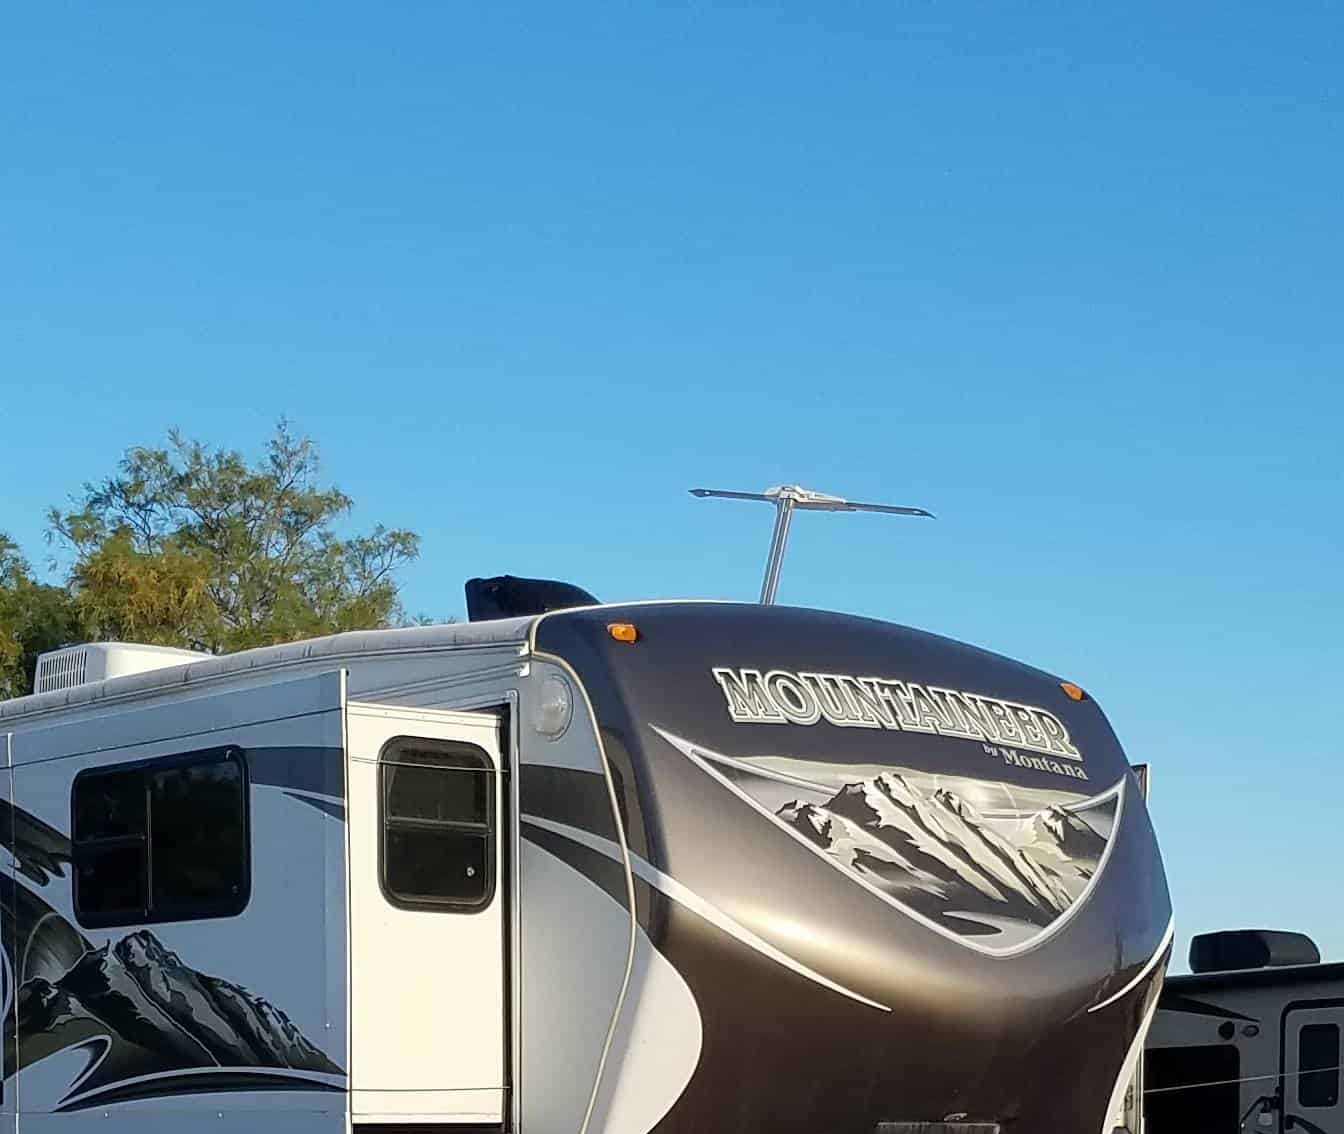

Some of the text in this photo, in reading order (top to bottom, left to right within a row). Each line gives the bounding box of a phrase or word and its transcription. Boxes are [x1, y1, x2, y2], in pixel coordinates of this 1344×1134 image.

[712, 667, 1082, 761] MOUNTAINEER
[981, 743, 1089, 780] by Montana
